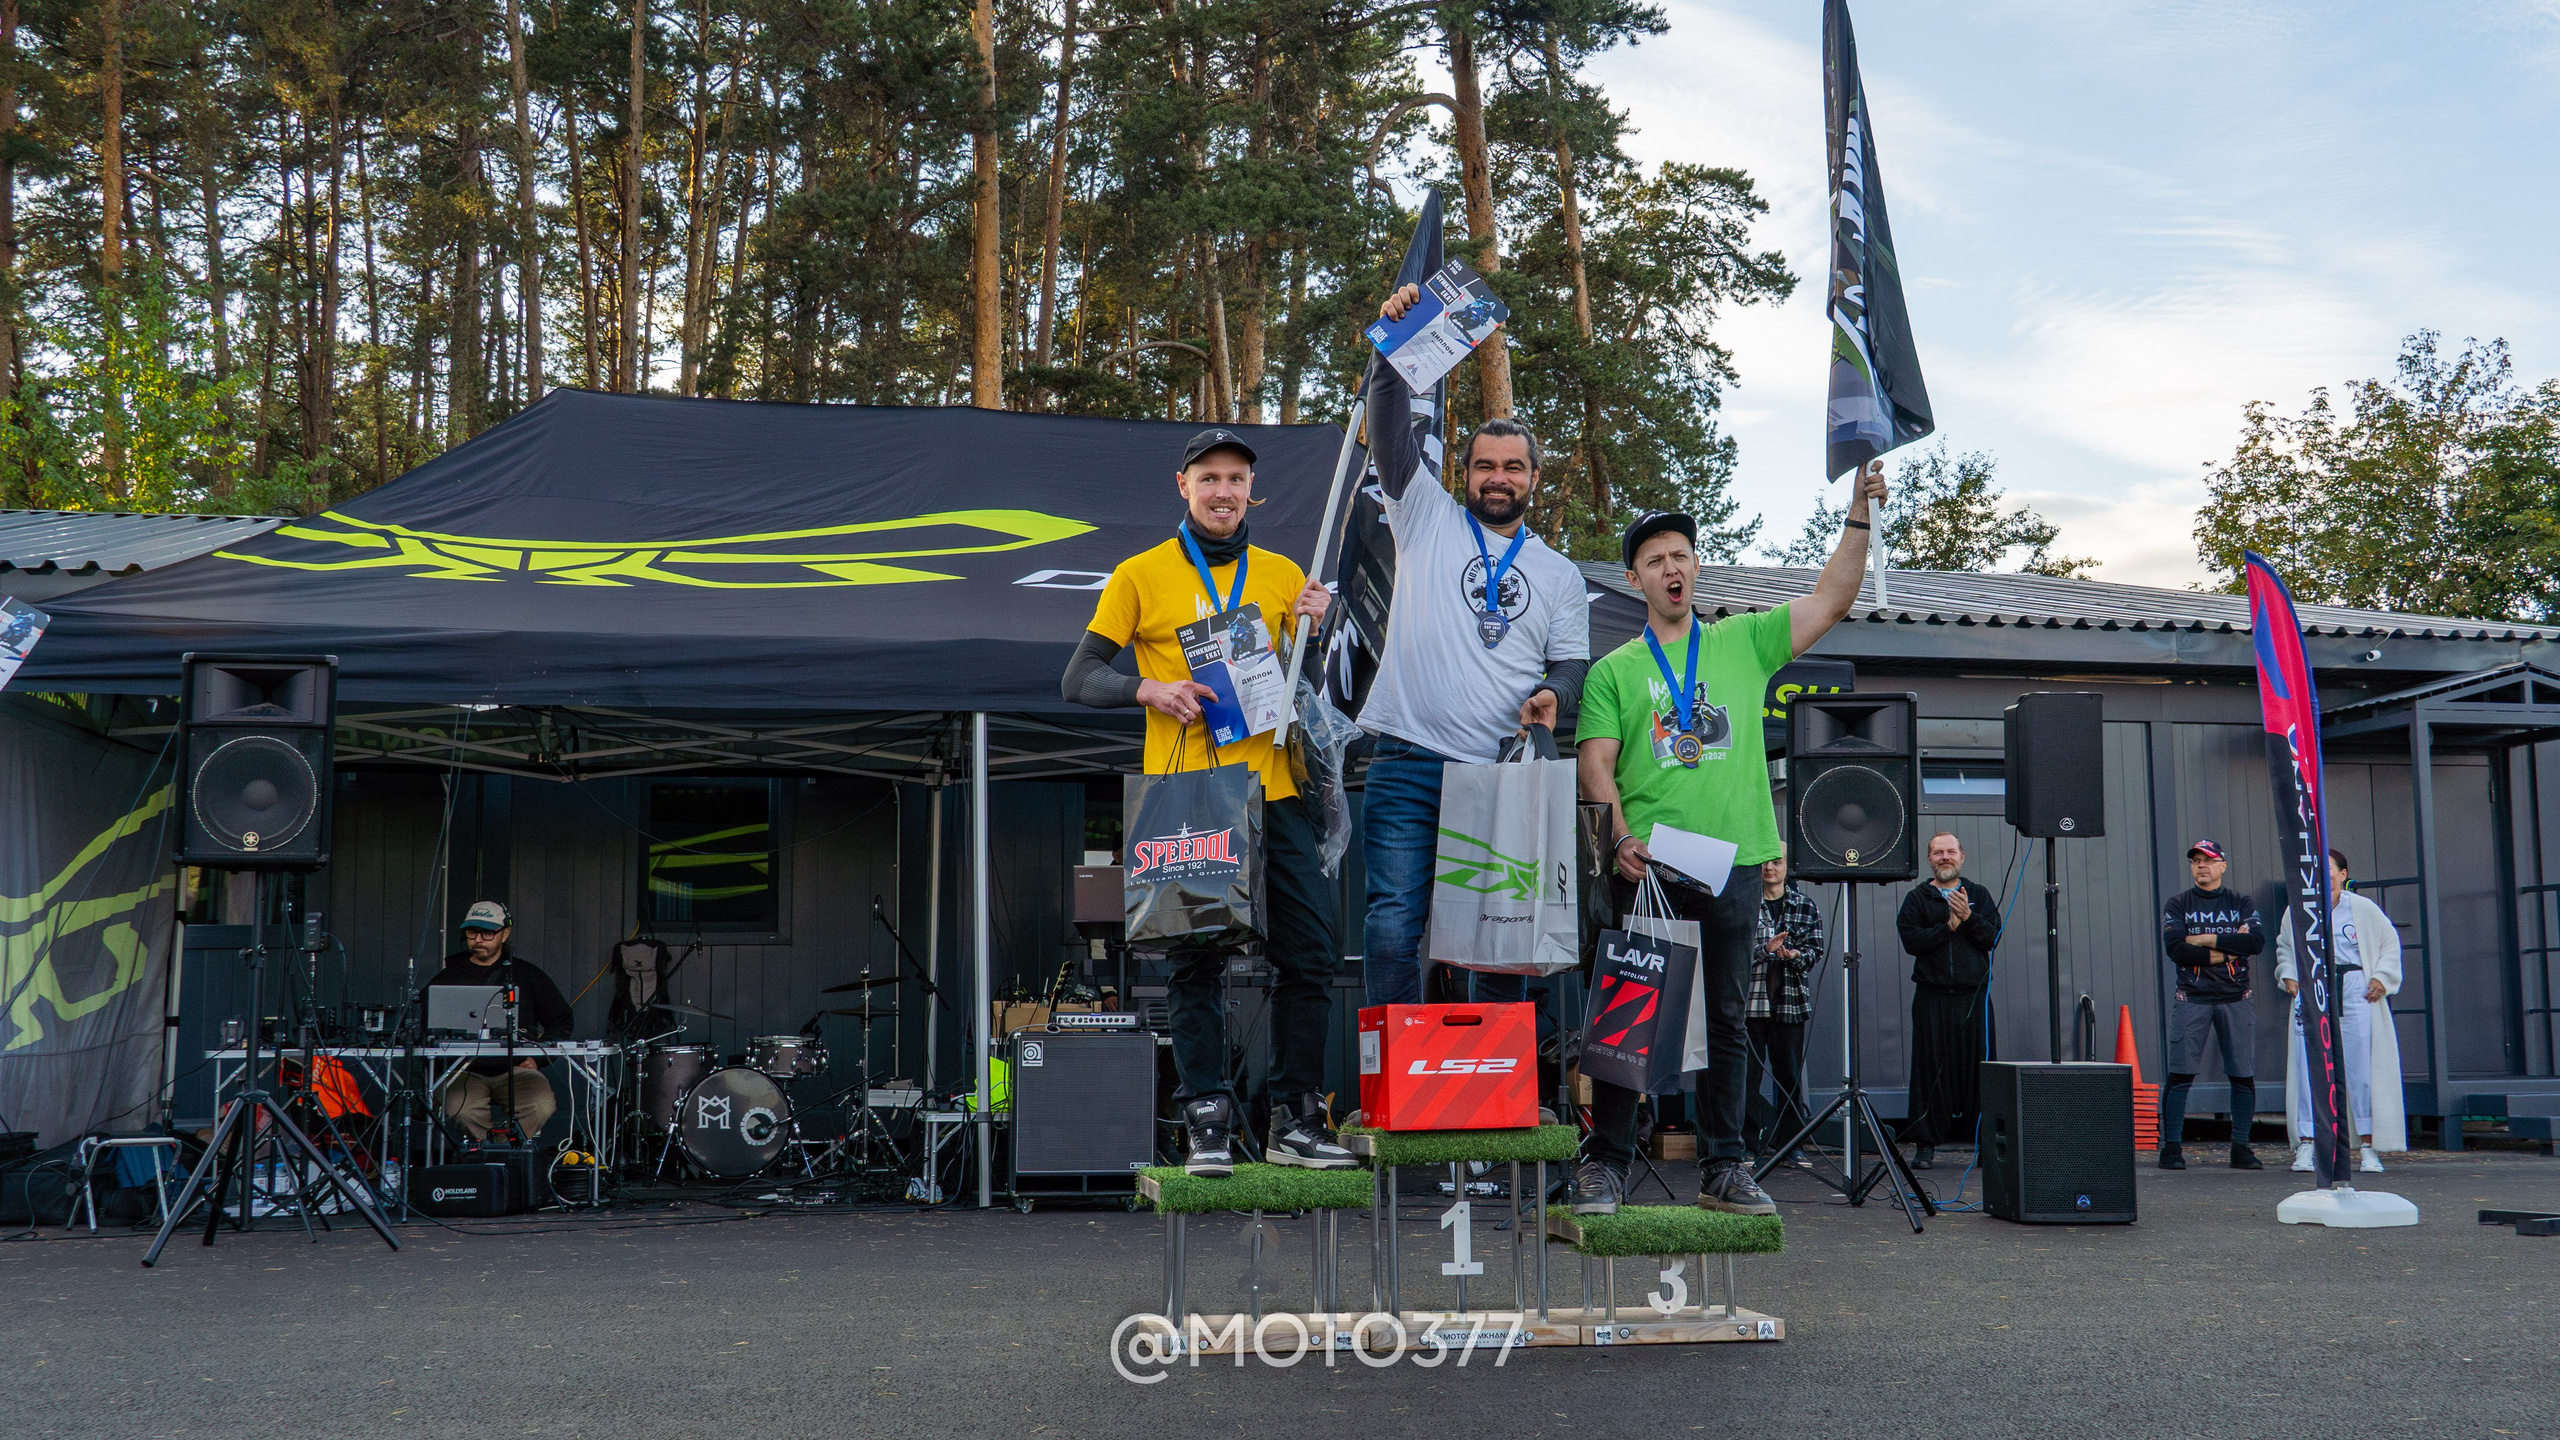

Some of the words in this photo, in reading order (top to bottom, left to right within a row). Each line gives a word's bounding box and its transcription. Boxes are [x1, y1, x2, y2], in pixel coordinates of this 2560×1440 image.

[1435, 274, 1460, 299] GYMKHANA
[1440, 290, 1454, 304] EKAT
[1430, 330, 1454, 356] ДИПЛОМ
[1188, 642, 1219, 658] GYMKHANA
[1206, 650, 1221, 661] EKAT
[1241, 670, 1273, 685] ДИПЛОМ
[1131, 827, 1240, 878] SPEEDOL
[1162, 864, 1185, 874] Since
[1187, 861, 1207, 870] 1921
[1130, 874, 1182, 886] Lubricants
[1199, 868, 1240, 876] Greases
[1558, 861, 1567, 910] DF
[2185, 910, 2240, 924] ММАЙ
[2188, 927, 2201, 935] НЕ
[1606, 943, 1665, 973] LAVR
[1619, 970, 1648, 982] MOTOLINE
[1407, 1058, 1518, 1075] LS2
[1197, 1106, 1215, 1115] PUMA
[1441, 1201, 1483, 1276] 1
[1237, 1220, 1280, 1295] 2
[1647, 1254, 1688, 1315] 3
